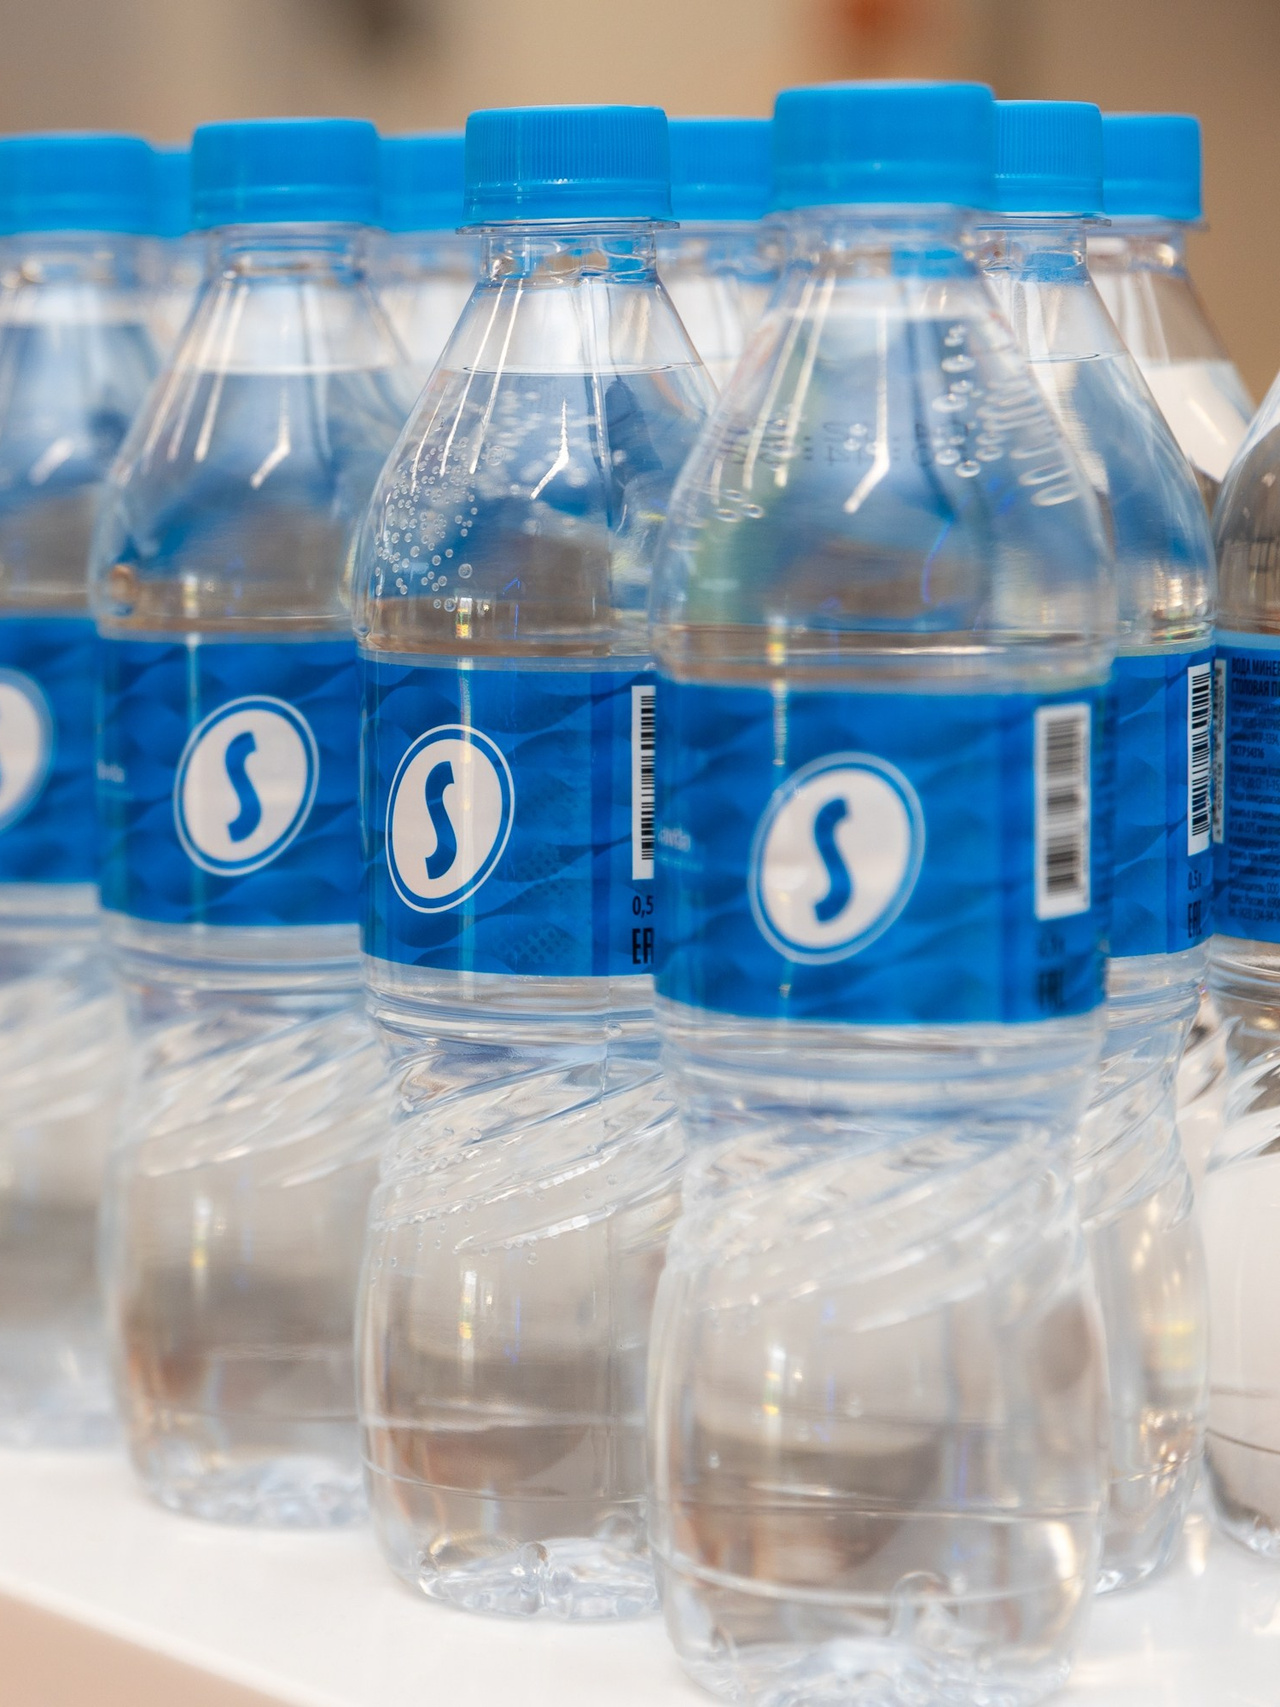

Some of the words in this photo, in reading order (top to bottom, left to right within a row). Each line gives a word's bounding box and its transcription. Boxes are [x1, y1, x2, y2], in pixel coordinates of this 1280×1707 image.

[1232, 656, 1250, 677] ВОДА
[224, 731, 262, 843] S
[424, 760, 458, 880] S
[814, 797, 854, 927] S
[632, 895, 654, 919] 0,5
[632, 928, 654, 964] EA
